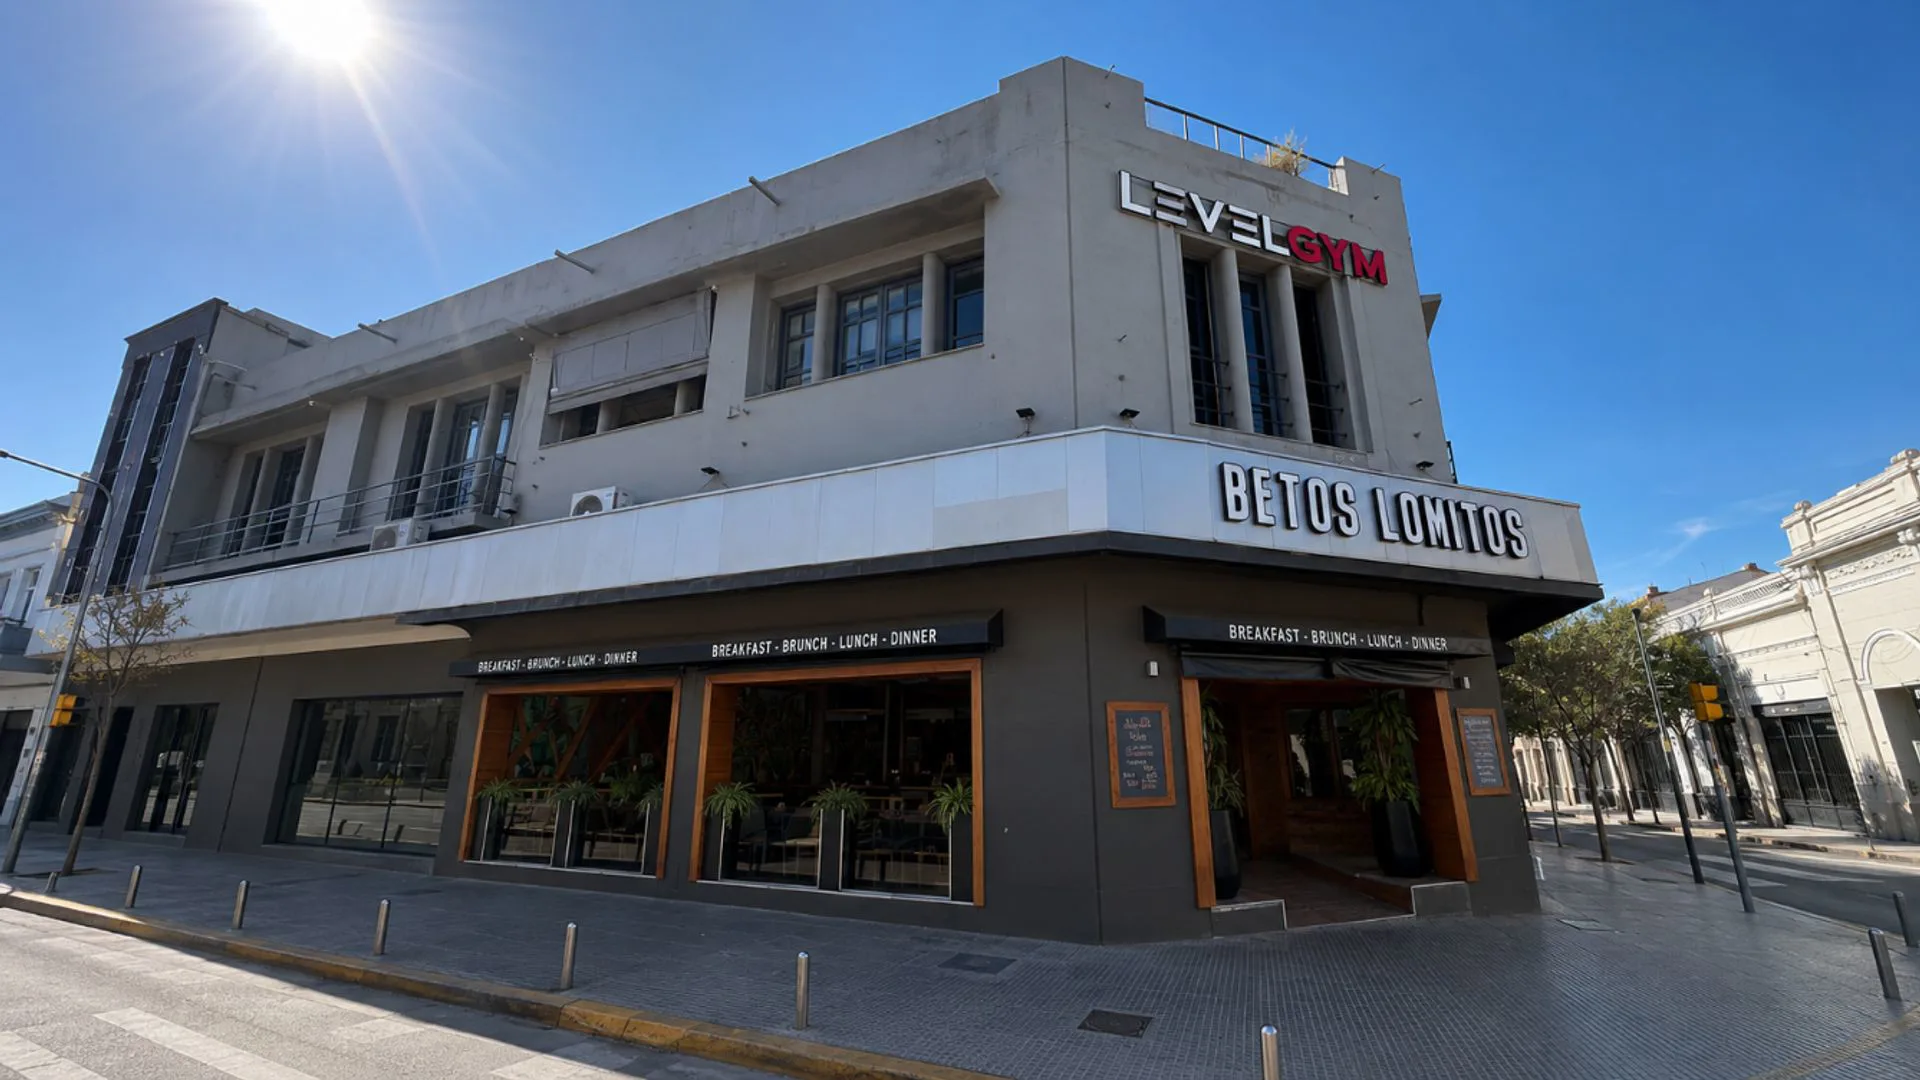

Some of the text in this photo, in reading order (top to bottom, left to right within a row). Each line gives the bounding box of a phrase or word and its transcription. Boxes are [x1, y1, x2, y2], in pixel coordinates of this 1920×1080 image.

[1220, 461, 1529, 559] BETOS LOMITOS
[712, 628, 937, 658] BREAKFAST BRUNCH LUNCH DINNER
[1229, 624, 1448, 651] BREAKFAST BRUNCH LUNCH DINNER
[478, 651, 638, 672] BREAKFAST BRUNCH LUNCH DINNER
